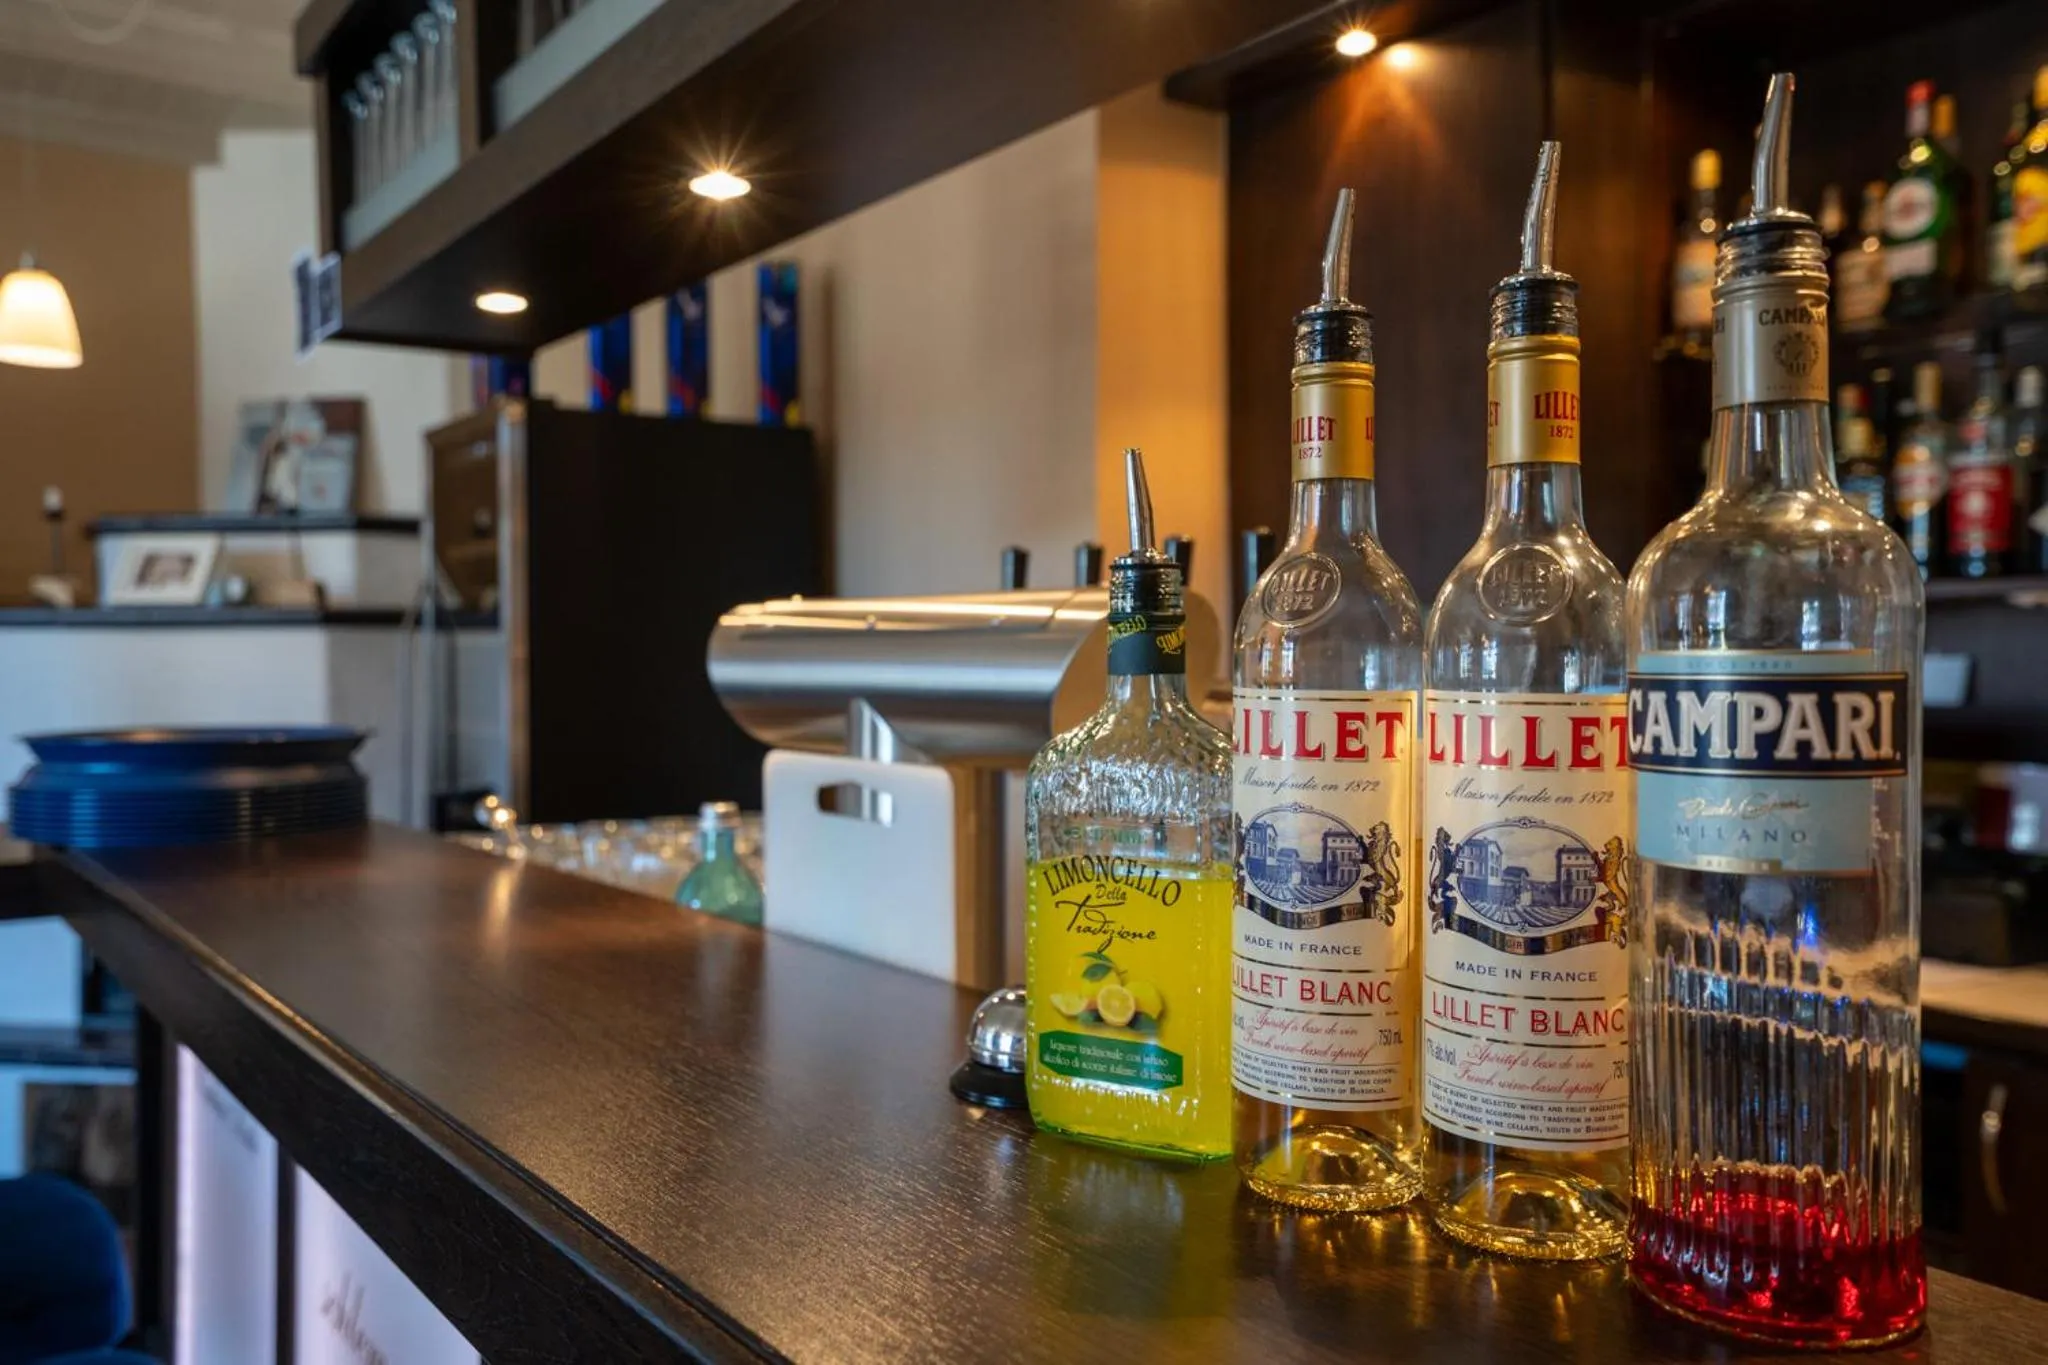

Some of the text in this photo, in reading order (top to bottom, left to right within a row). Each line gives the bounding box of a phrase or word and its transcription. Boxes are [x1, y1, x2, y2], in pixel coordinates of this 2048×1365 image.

[1534, 392, 1578, 420] LILLE
[1298, 447, 1322, 460] 1872
[1231, 707, 1406, 761] ILLET
[1429, 711, 1628, 772] LILLET
[1321, 782, 1339, 792] en
[1344, 778, 1382, 793] 1872
[1446, 777, 1499, 801] Maison
[1555, 794, 1572, 804] en
[1579, 790, 1614, 804] 1872
[1676, 823, 1807, 843] MILANO
[1043, 855, 1182, 907] LIMONCELLO
[1055, 894, 1156, 954] Tradizione
[1244, 934, 1362, 956] MADE IN FRANCE
[1456, 961, 1597, 982] MADE IN FRANCE
[1300, 979, 1392, 1006] BLANC
[1432, 991, 1625, 1036] LILLET BLANC
